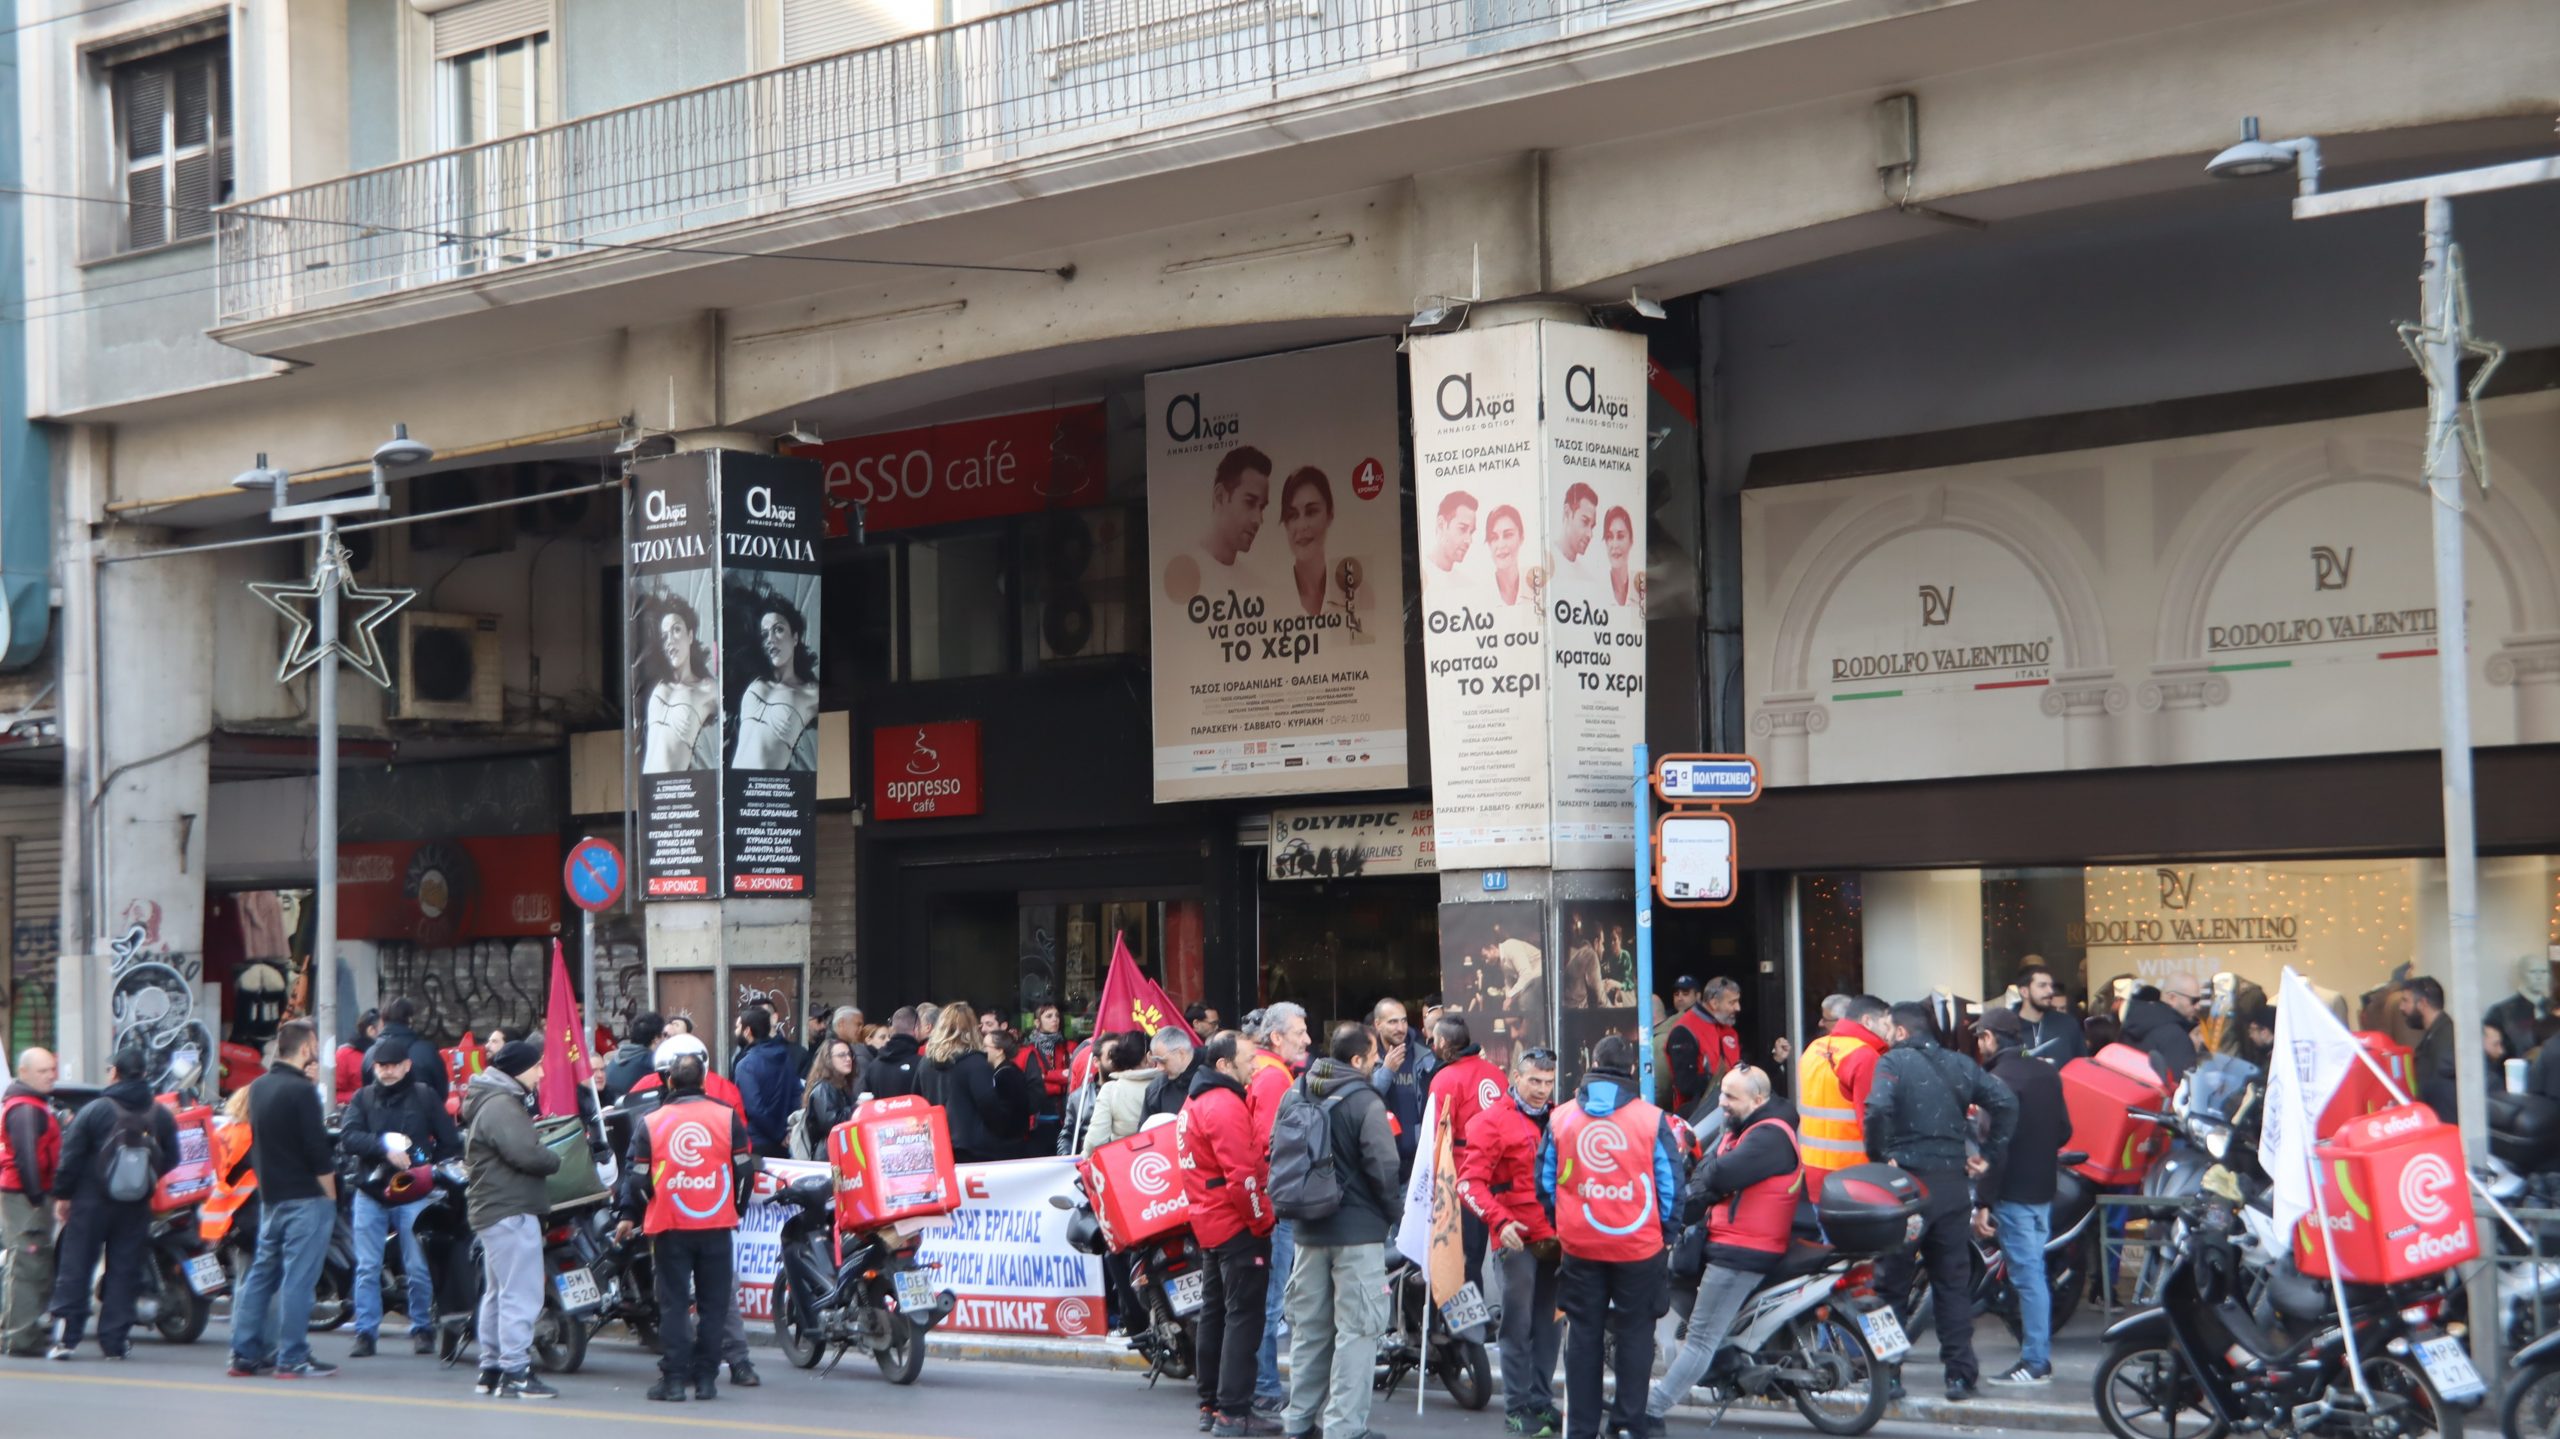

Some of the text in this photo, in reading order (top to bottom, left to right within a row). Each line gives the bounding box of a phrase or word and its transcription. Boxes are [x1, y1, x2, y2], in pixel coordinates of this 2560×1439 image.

[1425, 441, 1531, 464] ΤΑΣΟΣ ΙΟΡΔΑΝΙΔΗΣ
[1555, 438, 1640, 458] ΤΑΣΟΣ ΙΟΡΔΑΝΙΔΗΣ
[946, 440, 1016, 492] café
[1435, 458, 1520, 477] ΘΑΛΕΙΑ ΜΑΤΙΚΑ
[1564, 455, 1631, 472] ΘΑΛΕΙΑ ΜΑΤΙΚΑ
[632, 534, 705, 564] ΤΖΟΥΛΙΑ
[727, 533, 815, 561] ΤΖΟΥΛΙΑ
[1208, 624, 1228, 640] να
[1235, 620, 1267, 637] σου
[1476, 631, 1539, 649] να σου
[1594, 632, 1611, 646] να
[2208, 619, 2322, 648] RODOLFO
[1832, 641, 2049, 679] RODOLFO VALENTINO
[1190, 670, 1369, 695] ΤΑΣΟΣ ΙΟΡΔΑΝΙΔΗΣ ΘΑΛΕΙΑ ΜΑΤΙΚΑ
[1191, 723, 1237, 735] ΠΑΡΑΣΚΕΥΗ
[1244, 720, 1281, 732] ΣΑΒΒΑΤΟ
[1288, 718, 1323, 728] ΚΥΡΙΑΚΗ
[1693, 772, 1750, 785] ΠΟΛΥΤΕΧΝΕΙΟ
[888, 778, 960, 803] appresso
[913, 798, 935, 812] café
[1292, 812, 1400, 831] OLYMPIC
[662, 880, 699, 892] ΧΡΟΝΟΣ
[750, 878, 794, 889] ΧΡΟΝΟΣ
[2067, 917, 2297, 942] RODOLFO VALENTINO
[666, 1170, 716, 1189] efood
[1141, 1188, 1190, 1221] efood
[985, 1210, 1041, 1243] ΕΡΓΑΣΙΑΣ
[2405, 1220, 2469, 1264] efood
[986, 1255, 1087, 1288] ΔΙΚΑΙΩΜΑΤΩΝ
[956, 1300, 1048, 1330] ΑΤΤΙΚΗΣ
[1458, 1304, 1486, 1325] 263
